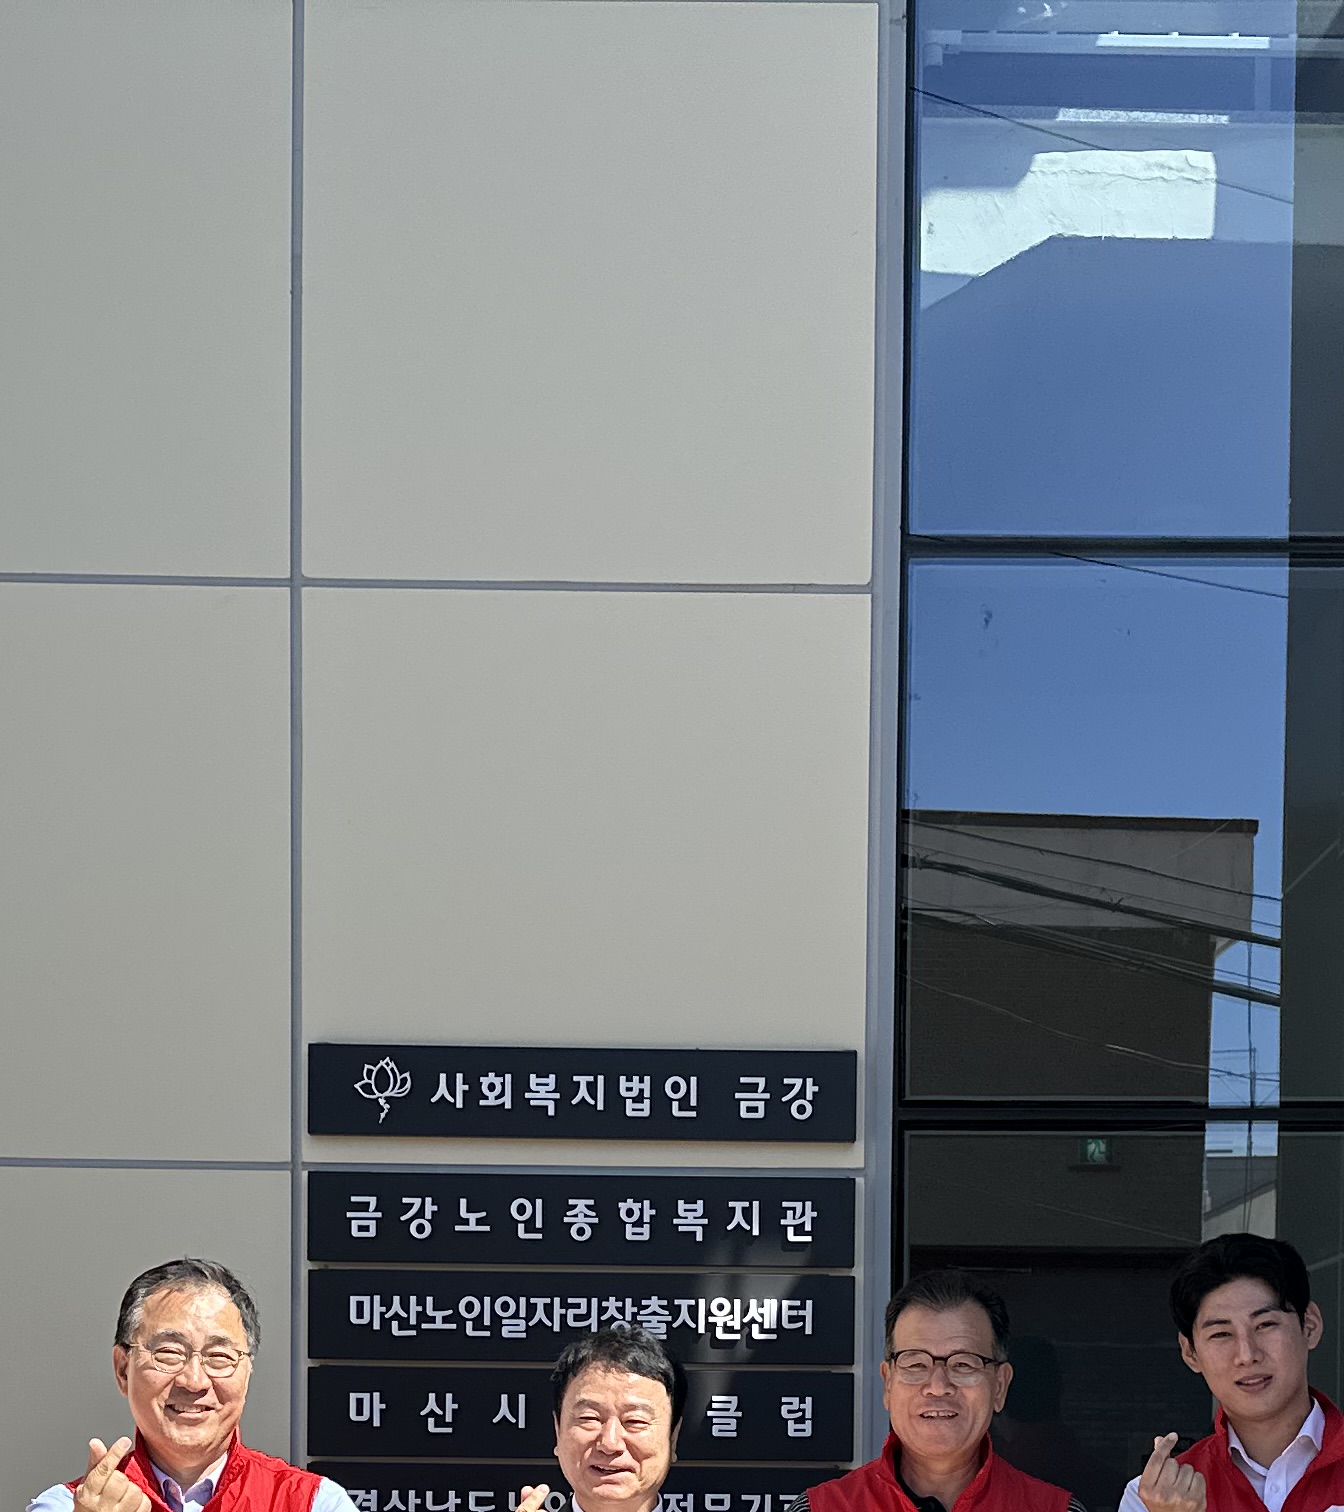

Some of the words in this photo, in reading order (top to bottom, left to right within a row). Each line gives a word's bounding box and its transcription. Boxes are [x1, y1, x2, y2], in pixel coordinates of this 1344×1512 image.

[430, 1071, 699, 1118] 사회복지법인
[734, 1075, 819, 1121] 금강
[346, 1195, 818, 1242] 금강노인종합복지관
[349, 1295, 813, 1340] 마산노인일자리창출지원센터
[349, 1392, 813, 1437] 마산시클럽
